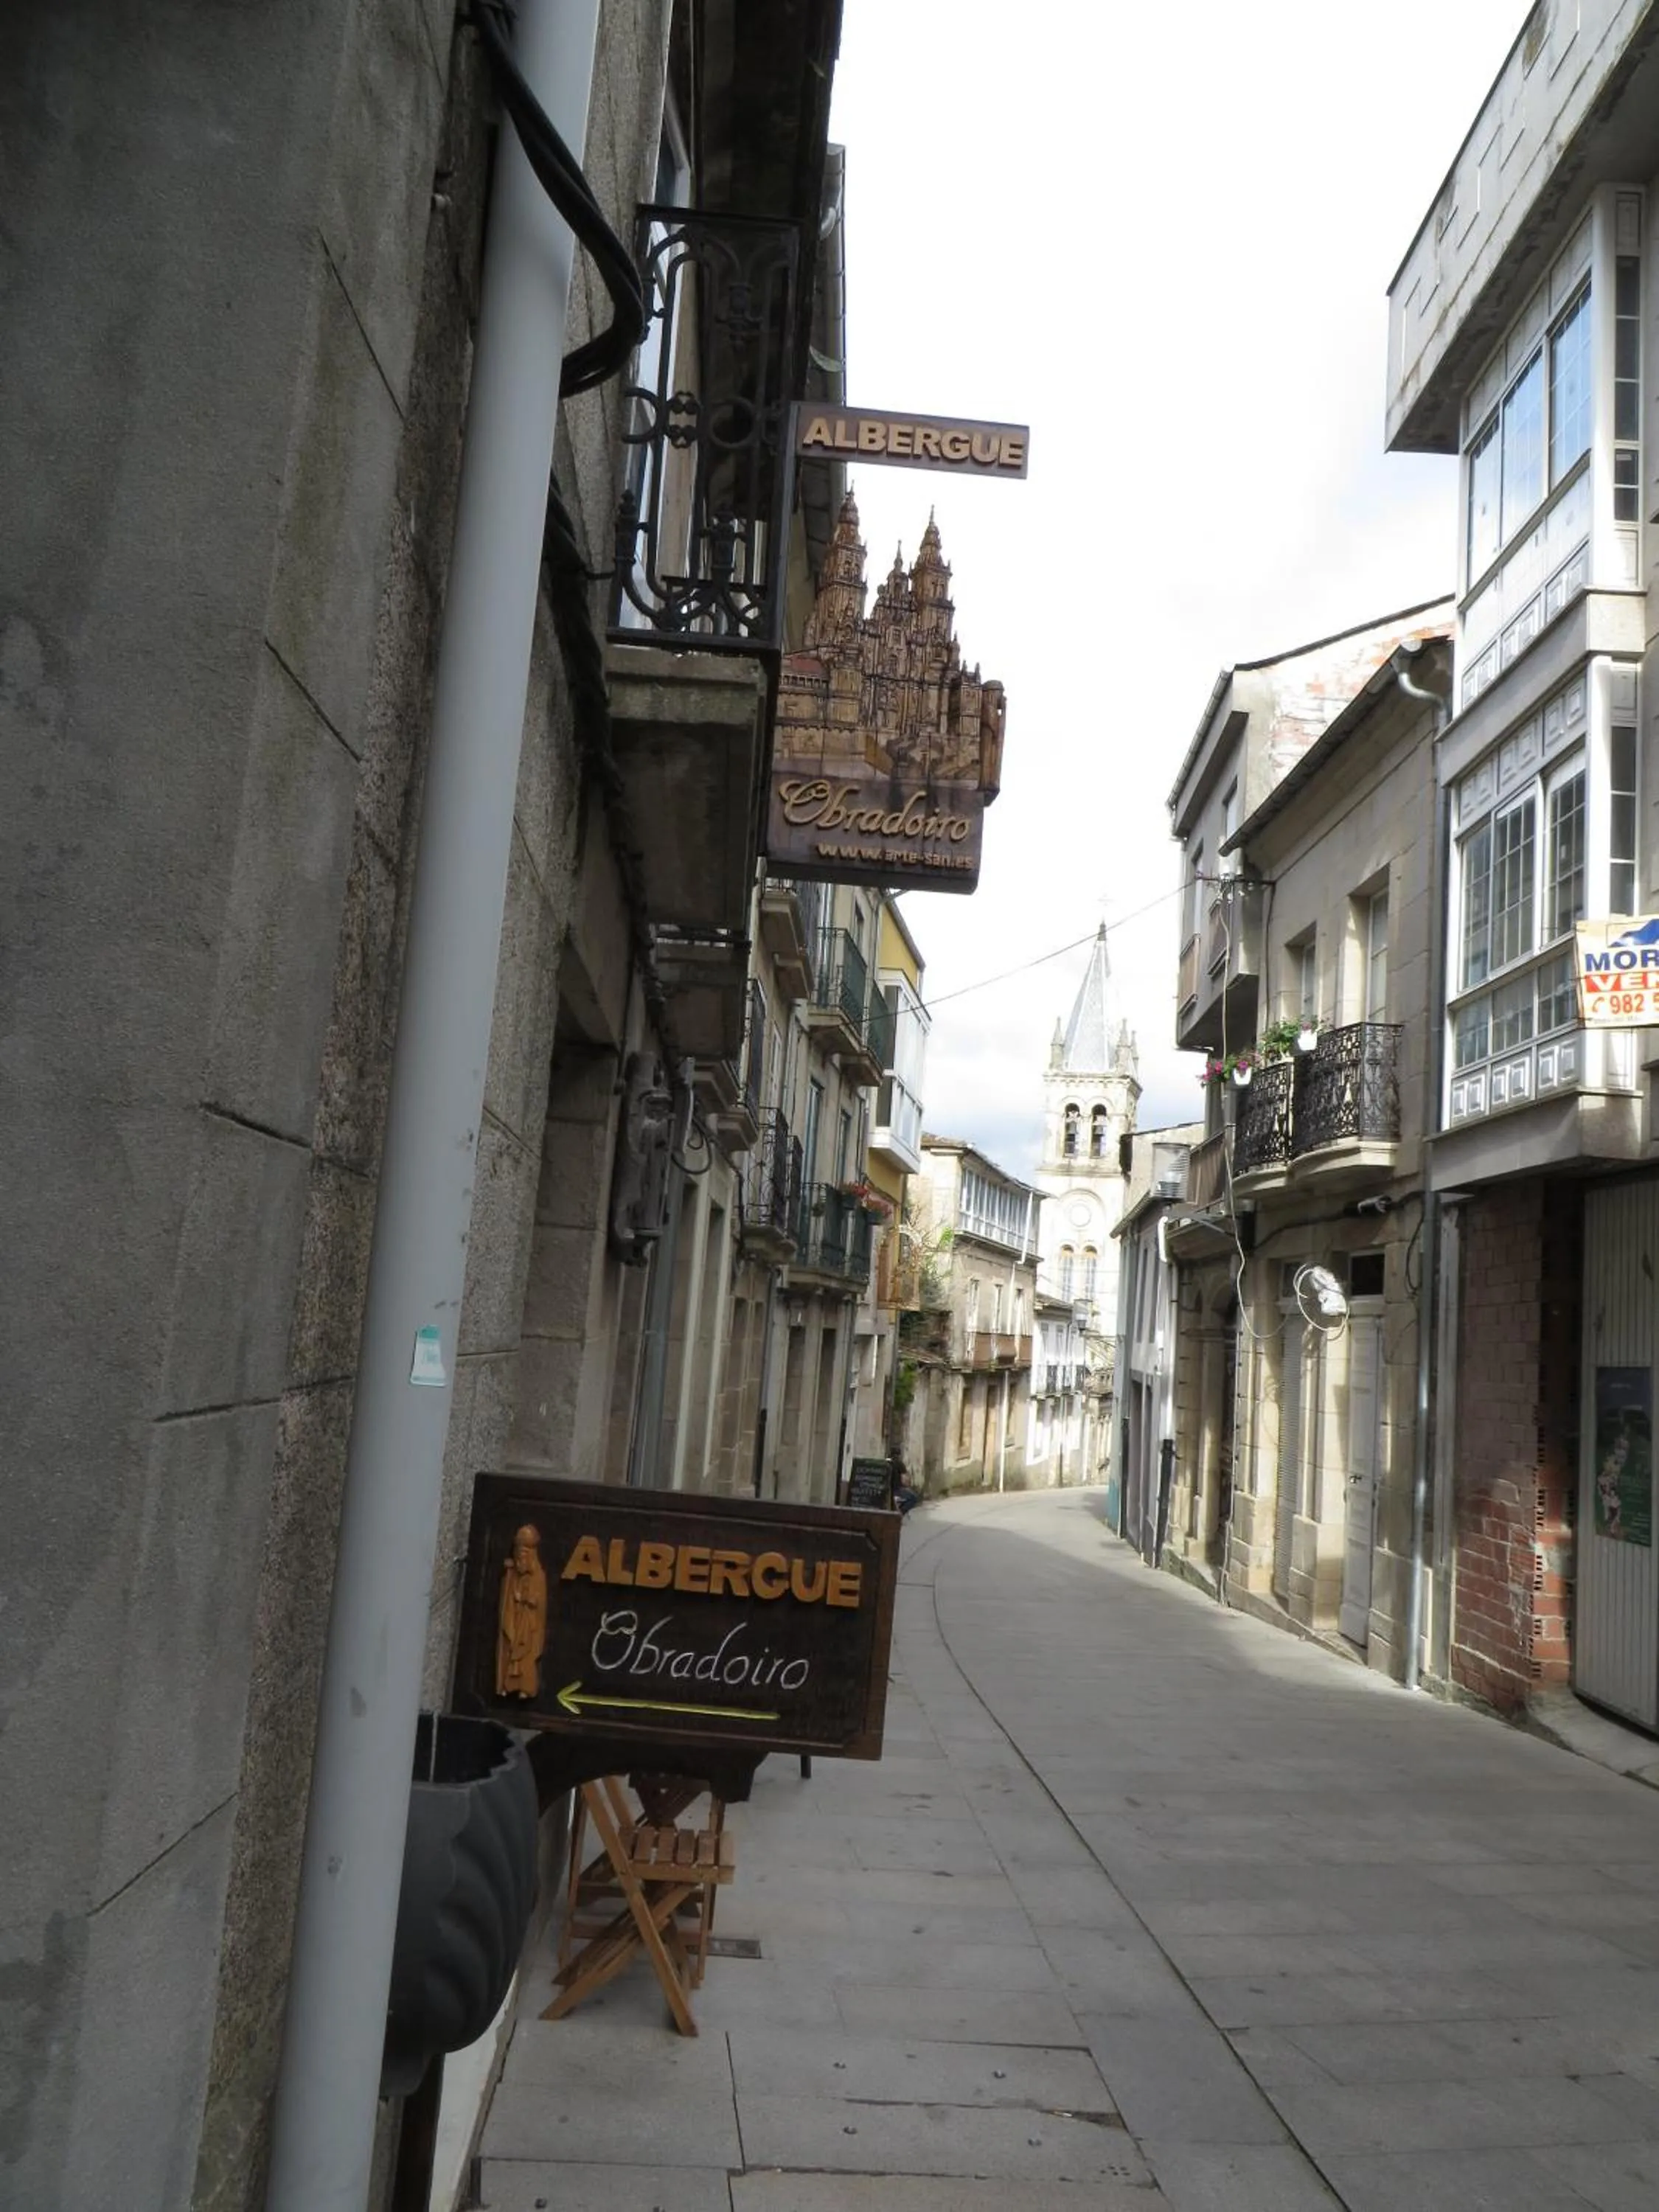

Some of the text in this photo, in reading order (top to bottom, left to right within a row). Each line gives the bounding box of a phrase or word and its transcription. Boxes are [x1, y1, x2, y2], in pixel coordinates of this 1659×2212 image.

[802, 417, 1024, 469] ALBERGUE
[779, 779, 972, 843] Obradoiro
[1610, 993, 1645, 1015] 982
[562, 1535, 863, 1607] ALBERGUE
[591, 1610, 810, 1690] Obradoiro
